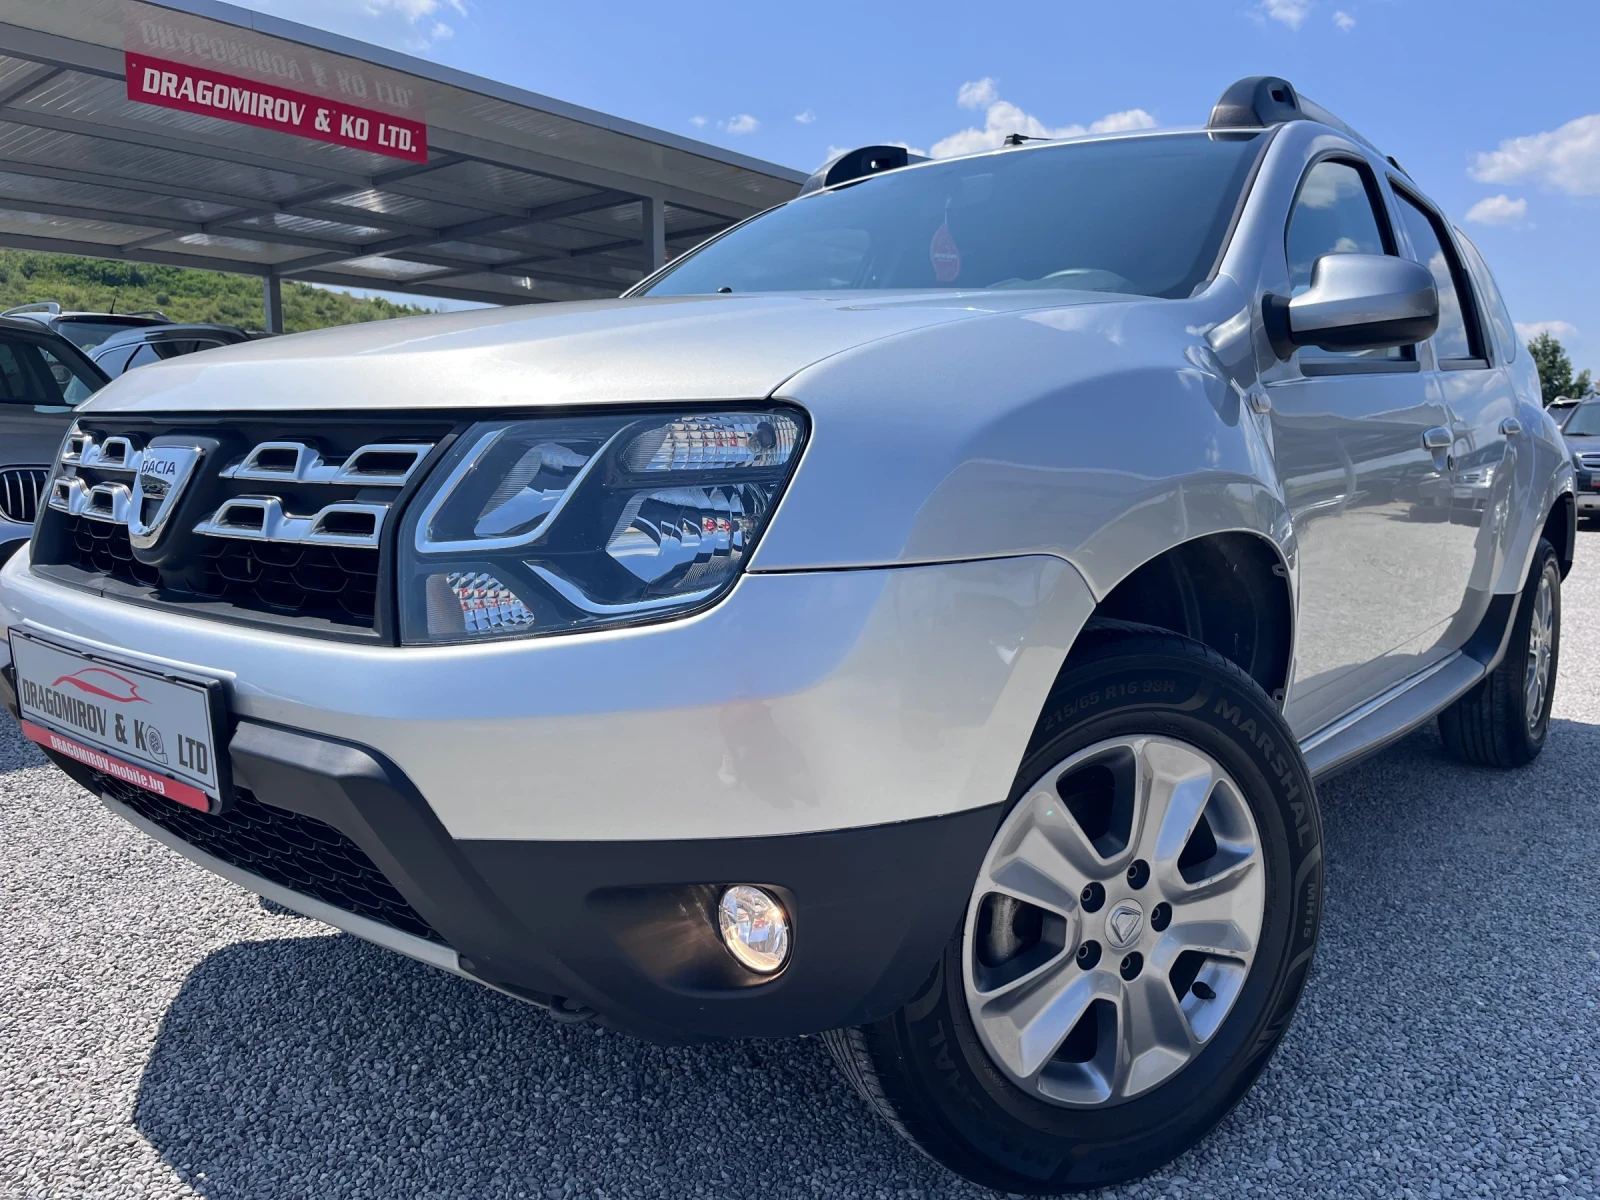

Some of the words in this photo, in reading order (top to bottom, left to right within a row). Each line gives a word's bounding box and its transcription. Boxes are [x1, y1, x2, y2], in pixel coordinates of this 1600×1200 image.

[142, 67, 306, 126] DRAGOMIROV
[314, 108, 331, 133] &
[340, 113, 369, 141] KO
[377, 123, 417, 153] LTD.
[141, 460, 176, 475] DACIA
[22, 678, 107, 737] DRAGOMIROV
[114, 713, 128, 745] &
[177, 733, 208, 775] LTD
[1043, 691, 1100, 732] 215/65
[1105, 681, 1138, 700] R16
[50, 735, 165, 795] DRAGOMIROV.mobile.bg
[1214, 696, 1311, 848] MARSHAL
[1303, 883, 1317, 939] MH15
